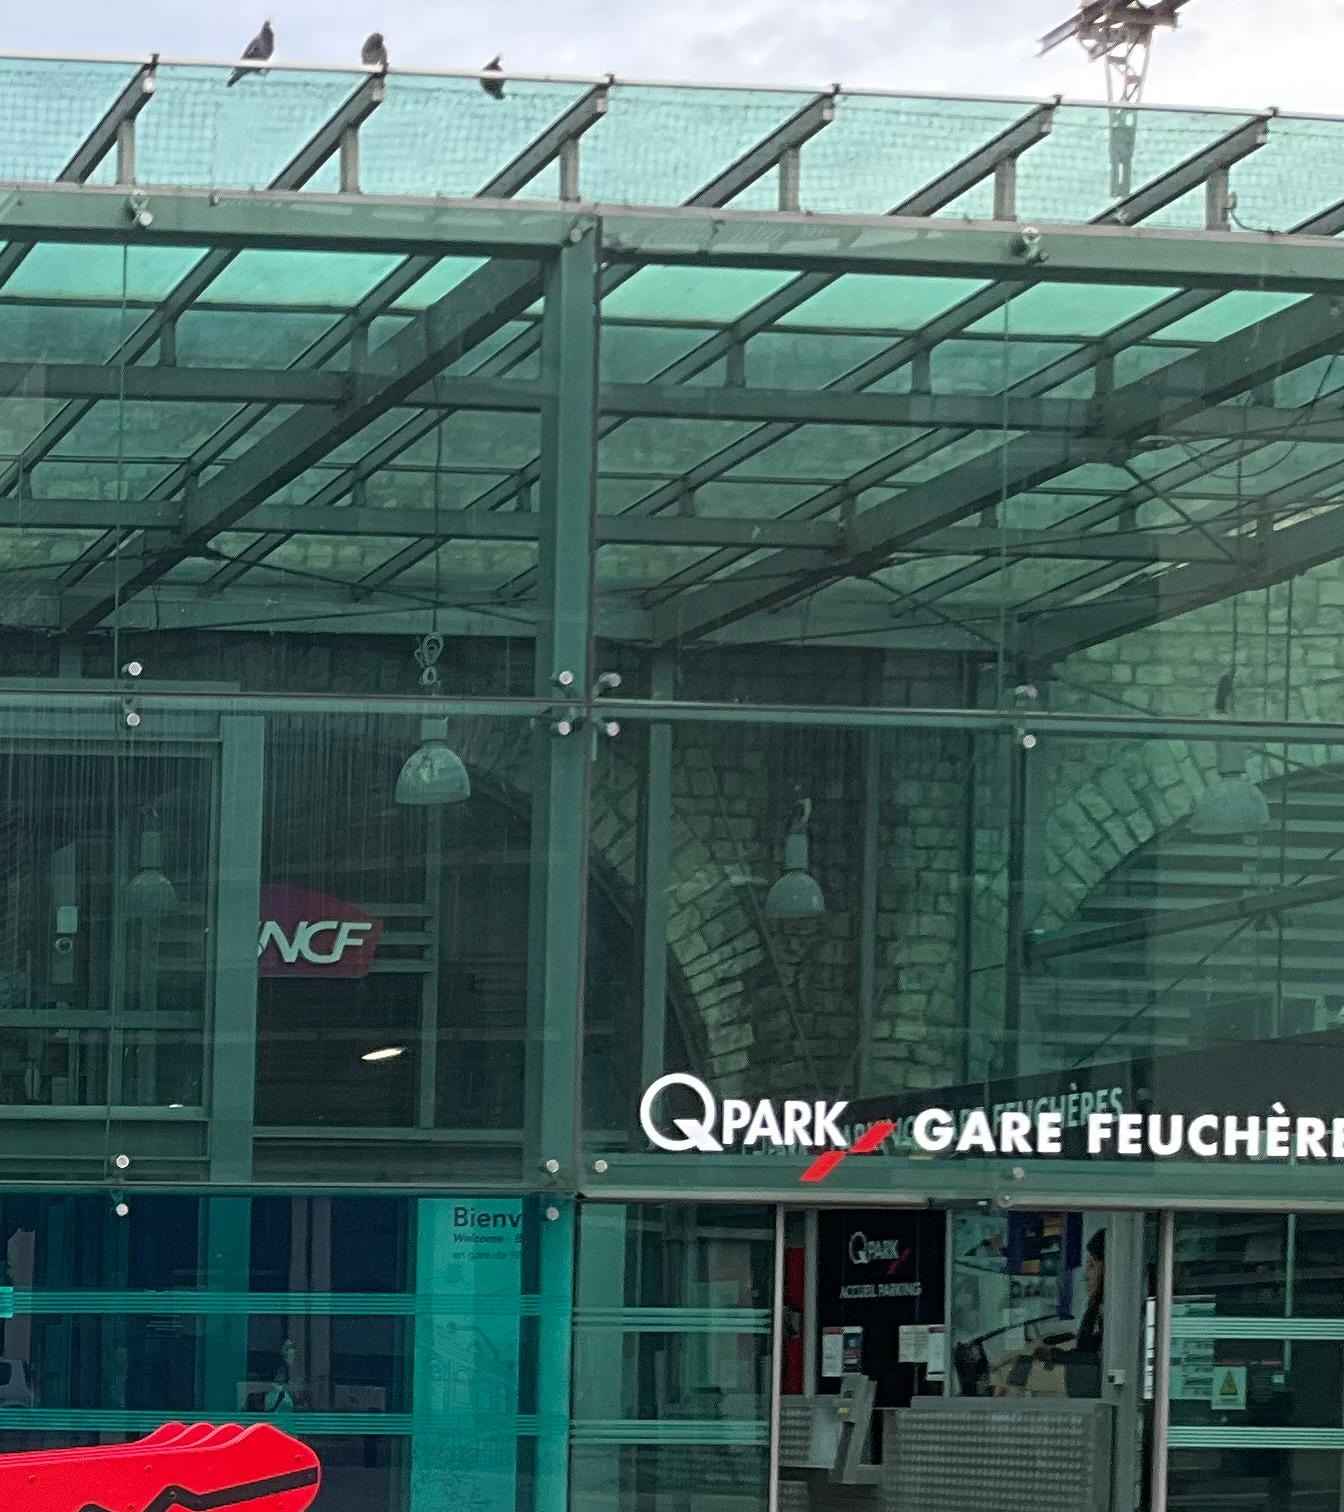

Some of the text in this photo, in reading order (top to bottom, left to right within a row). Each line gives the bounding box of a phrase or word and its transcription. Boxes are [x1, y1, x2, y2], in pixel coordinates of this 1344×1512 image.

[257, 920, 373, 964] NCF
[912, 1106, 1063, 1154] GARE
[452, 1232, 504, 1244] Welcome
